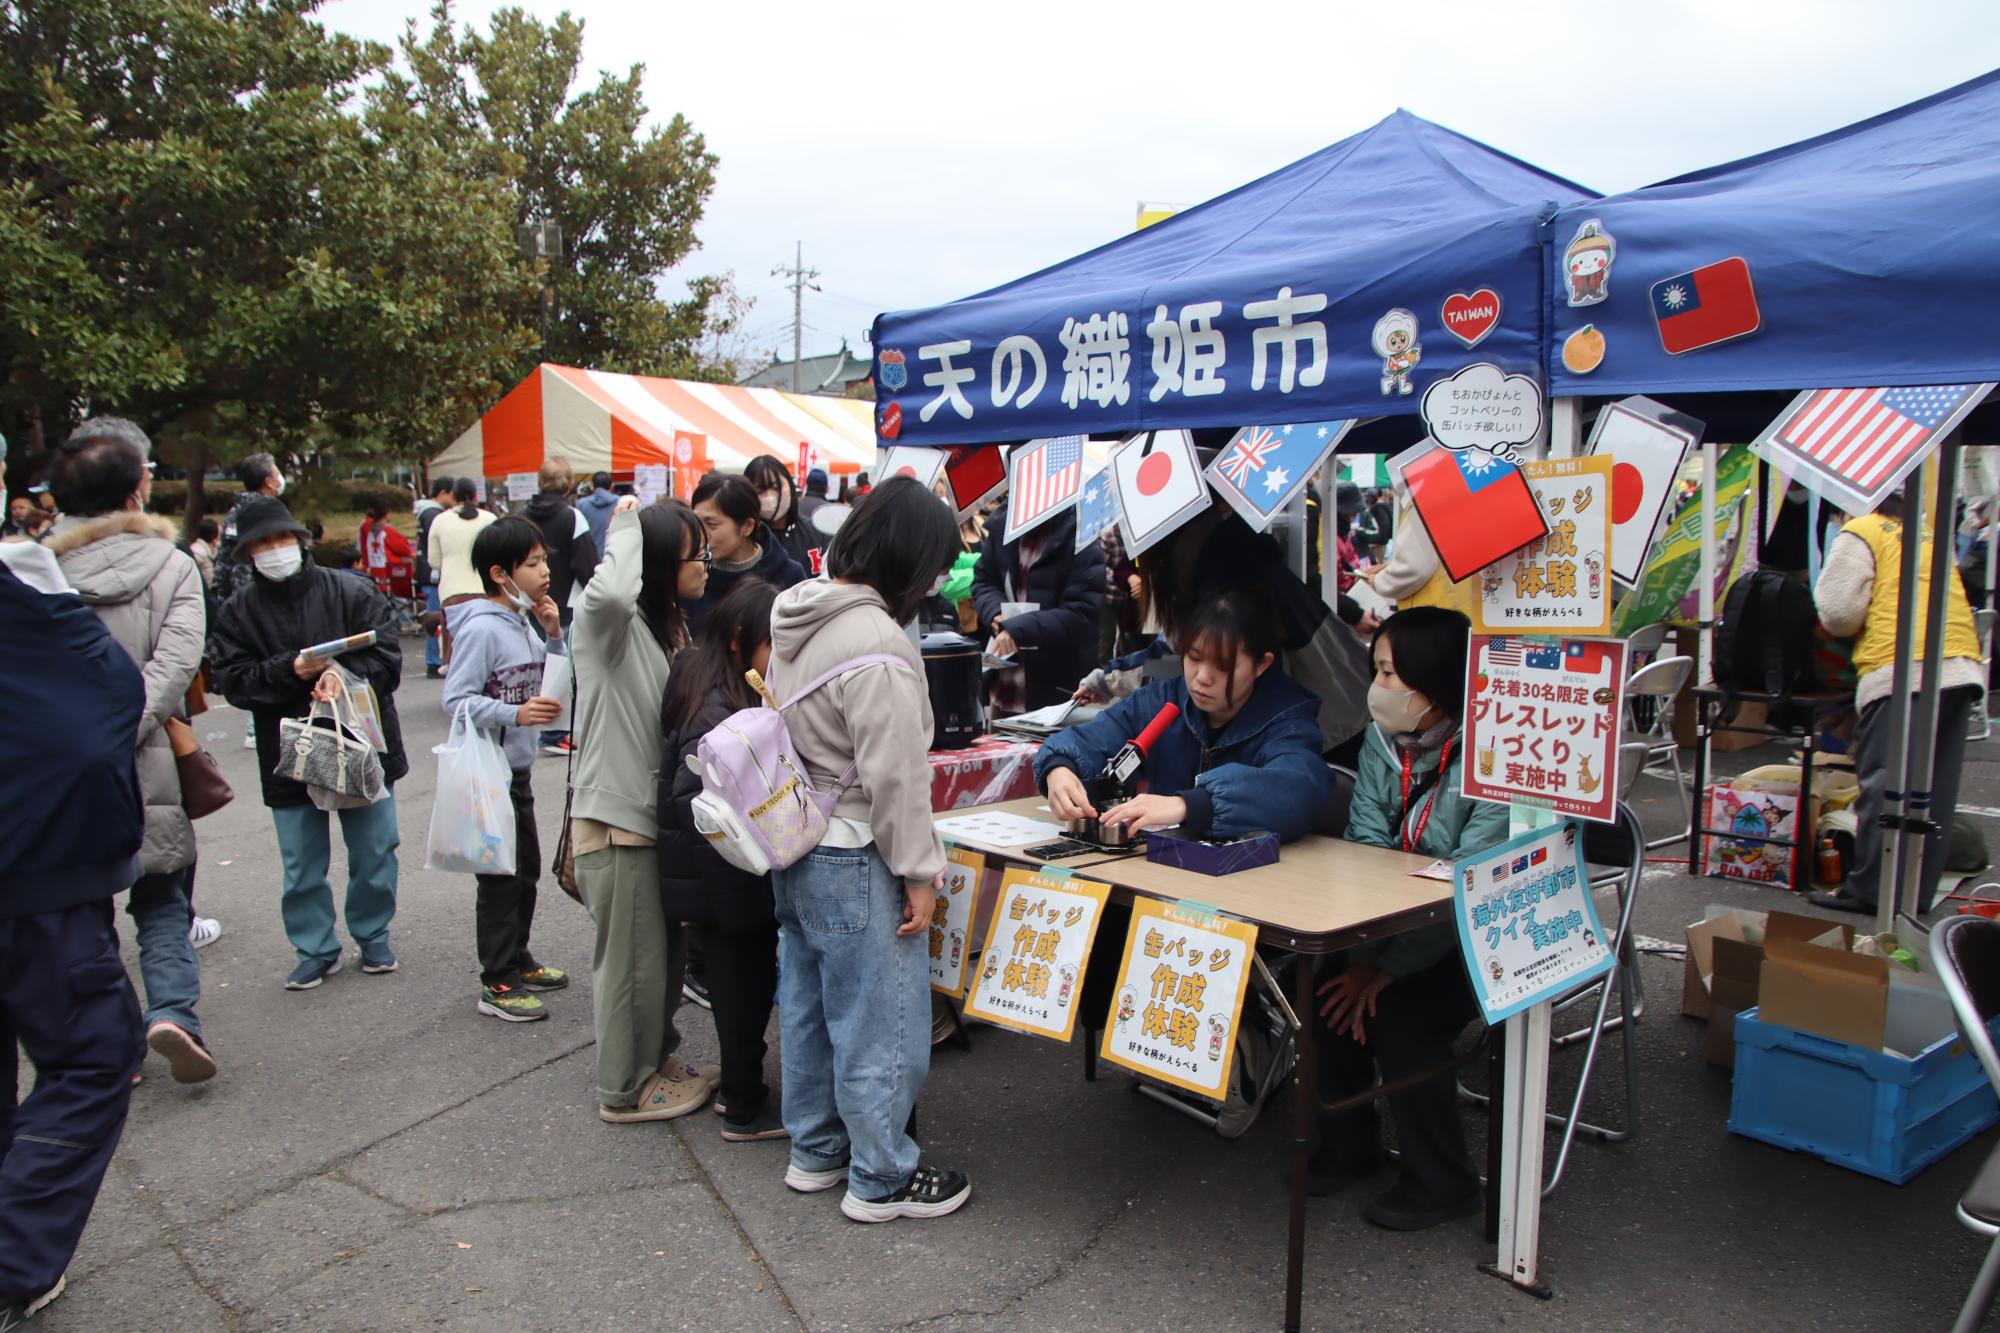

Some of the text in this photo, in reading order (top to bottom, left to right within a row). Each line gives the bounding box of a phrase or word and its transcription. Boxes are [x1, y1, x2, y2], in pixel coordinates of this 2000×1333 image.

[1448, 305, 1493, 324] TAIWAN
[918, 286, 1328, 422] 天の織姫市
[1449, 405, 1522, 416] コットベリーの
[1451, 389, 1522, 401] もおかぴょんと
[1512, 559, 1578, 599] 体験
[1504, 607, 1583, 618] 好きな柄がえらべる
[498, 687, 522, 704] THE
[1491, 678, 1589, 706] 先着30名限定
[1471, 698, 1614, 739] ブレスレッド
[1502, 734, 1571, 765] づくり
[1505, 762, 1567, 793] 実施中
[752, 790, 788, 818] LUV TEDDY
[1009, 893, 1084, 928] 缶バッジ
[1471, 865, 1577, 929] 海外友好都市
[1012, 923, 1062, 965] 作成
[1485, 907, 1537, 950] クイズ
[1532, 909, 1583, 951] 実施中
[1143, 927, 1232, 973] 缶バッジ
[1001, 957, 1053, 1001] 体験
[1150, 963, 1207, 1012] 作成
[988, 996, 1048, 1019] 好きな柄がえらべる
[1141, 1000, 1200, 1052] 体験
[1128, 1040, 1198, 1073] 好きな柄がえらべる
